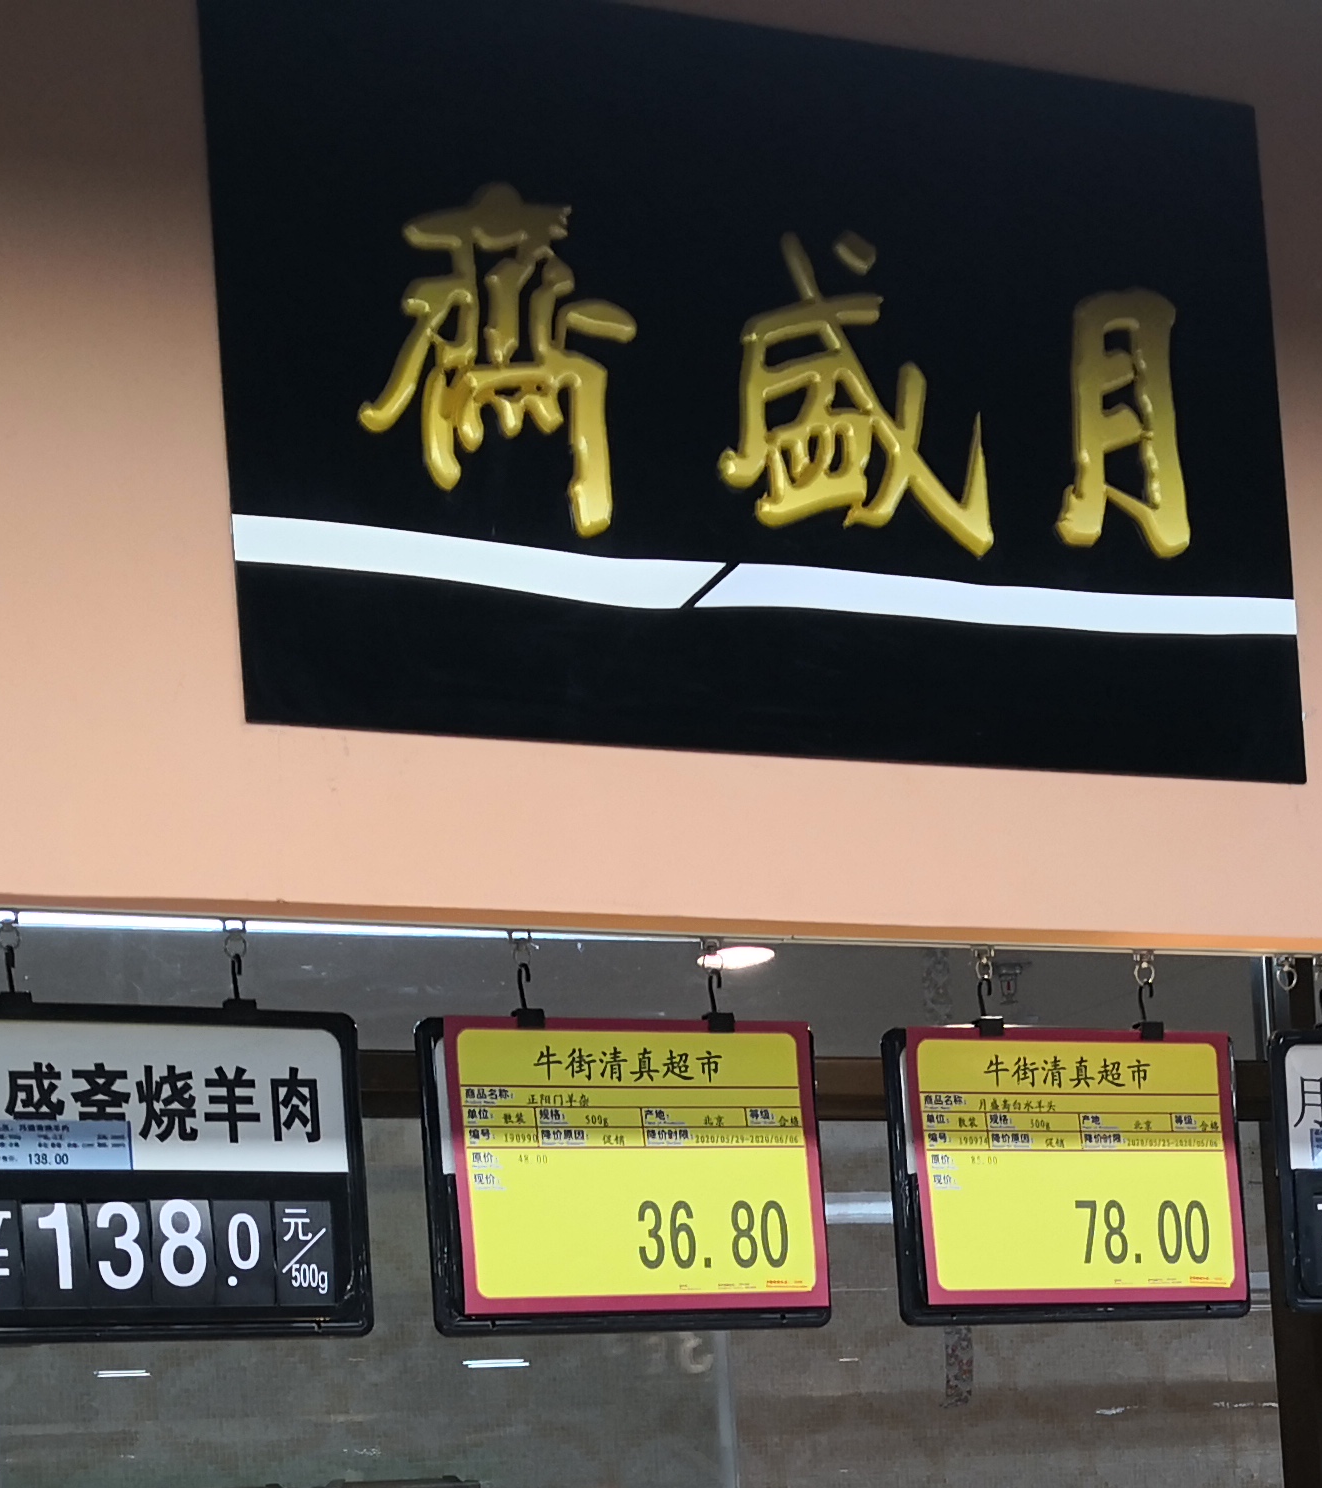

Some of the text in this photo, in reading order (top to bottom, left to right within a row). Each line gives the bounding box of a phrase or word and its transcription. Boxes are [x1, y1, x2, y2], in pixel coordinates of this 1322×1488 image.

[533, 1045, 722, 1082] 牛街清真超市
[984, 1054, 1151, 1089] 牛街清真超市
[527, 1093, 589, 1106] 正阳门羊杂
[703, 1114, 724, 1126] 北京
[28, 1153, 69, 1165] 138.00
[637, 1200, 789, 1269] 36.80
[1074, 1200, 1209, 1264] 78.00
